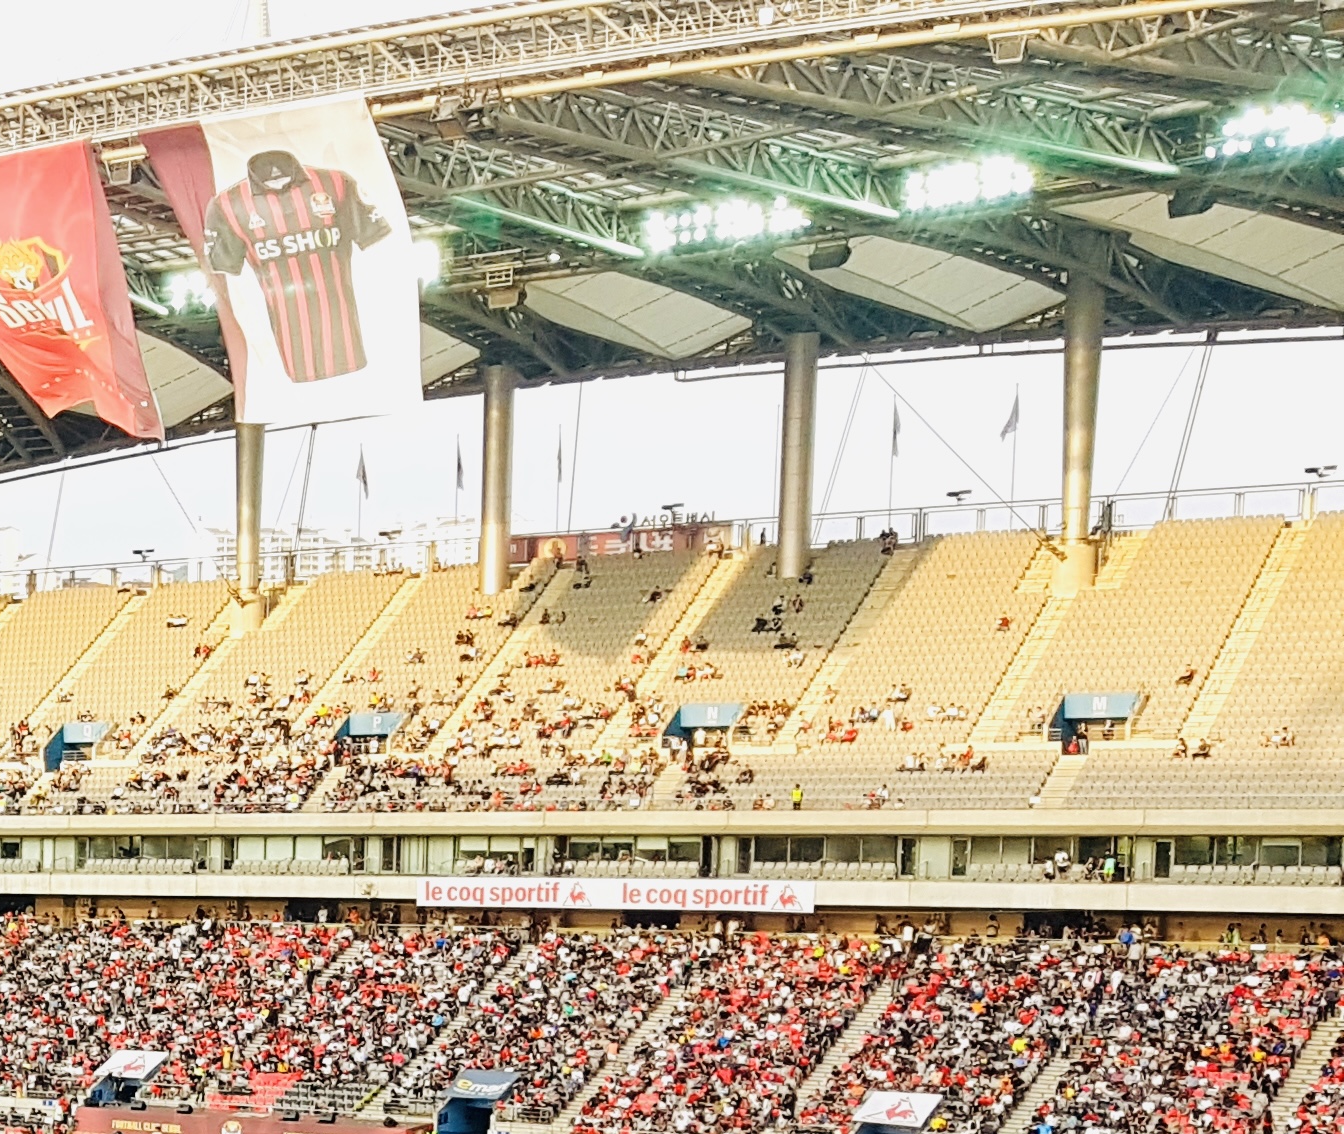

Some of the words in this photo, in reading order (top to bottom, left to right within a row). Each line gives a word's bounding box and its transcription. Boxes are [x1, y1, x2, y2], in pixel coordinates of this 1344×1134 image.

[254, 239, 281, 259] GS
[425, 881, 442, 901] le
[447, 885, 485, 905] coq
[489, 881, 560, 905] sportif
[622, 883, 641, 904] le
[646, 888, 687, 908] coq
[692, 884, 769, 908] sportif
